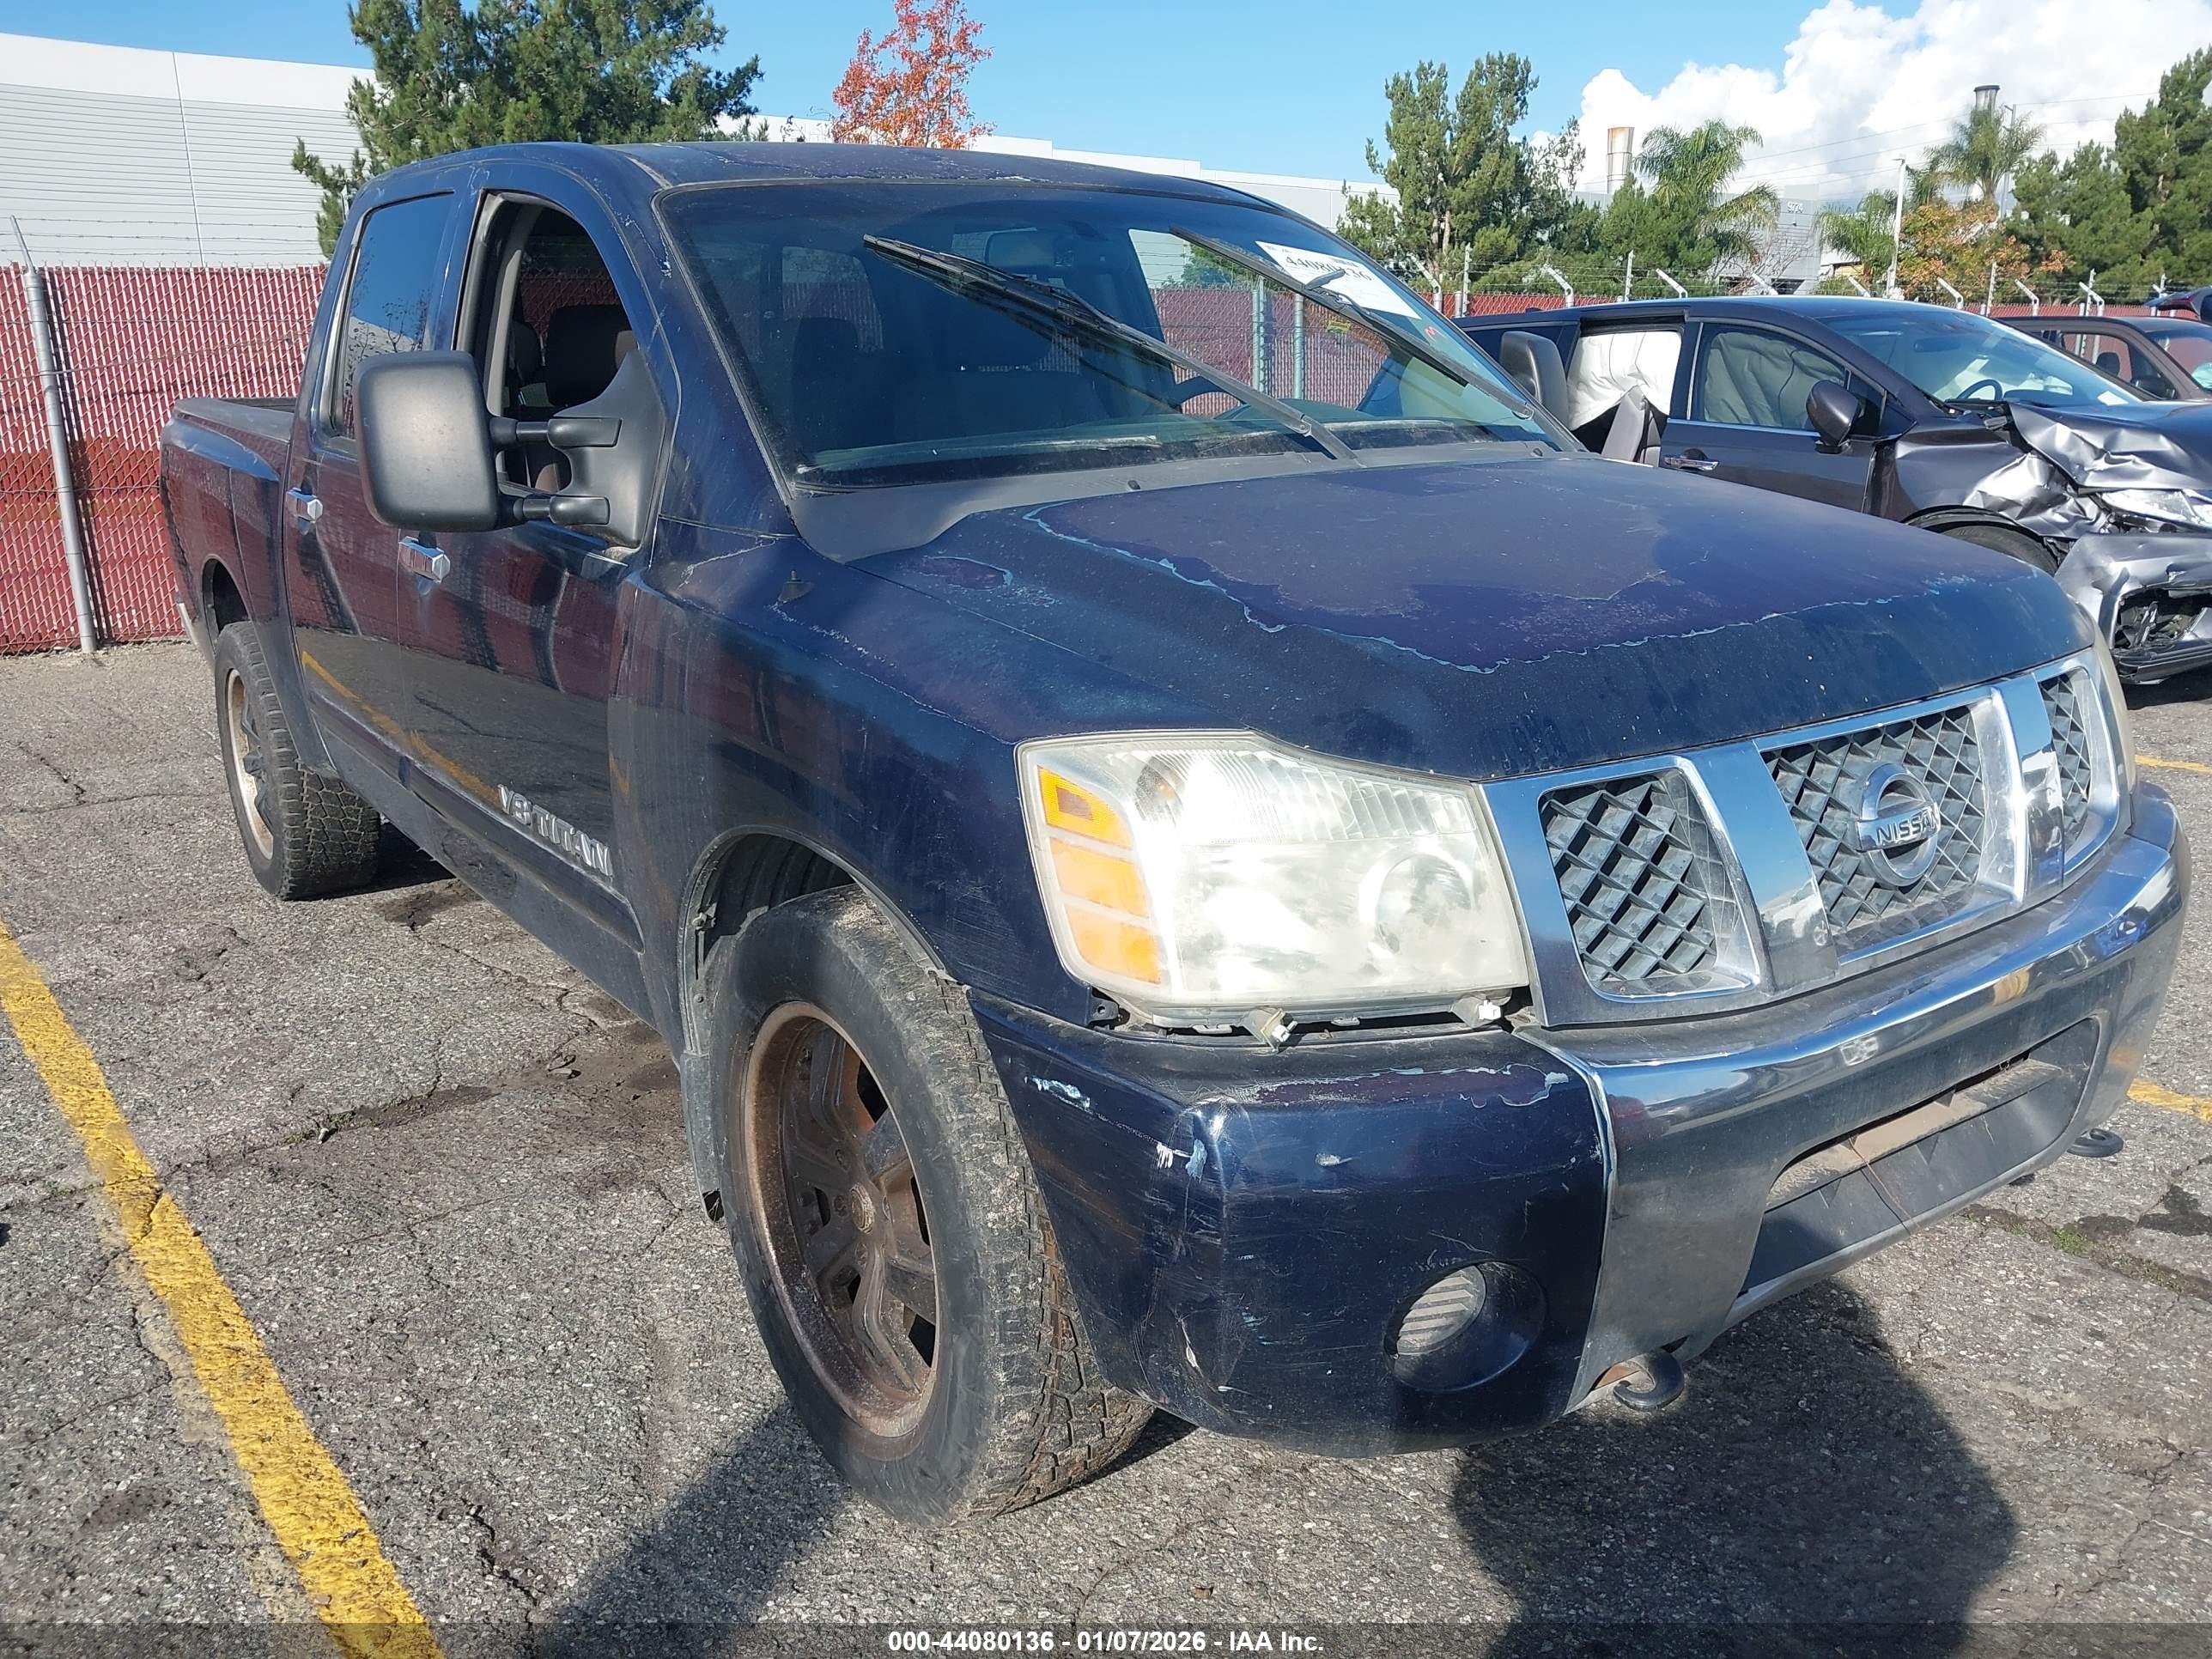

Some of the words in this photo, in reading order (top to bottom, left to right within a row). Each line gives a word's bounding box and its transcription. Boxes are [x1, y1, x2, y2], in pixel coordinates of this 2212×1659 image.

[1285, 256, 1372, 282] 4408036
[497, 783, 533, 826] V8
[532, 804, 614, 877] TITAN
[1875, 805, 1941, 846] NISSAN
